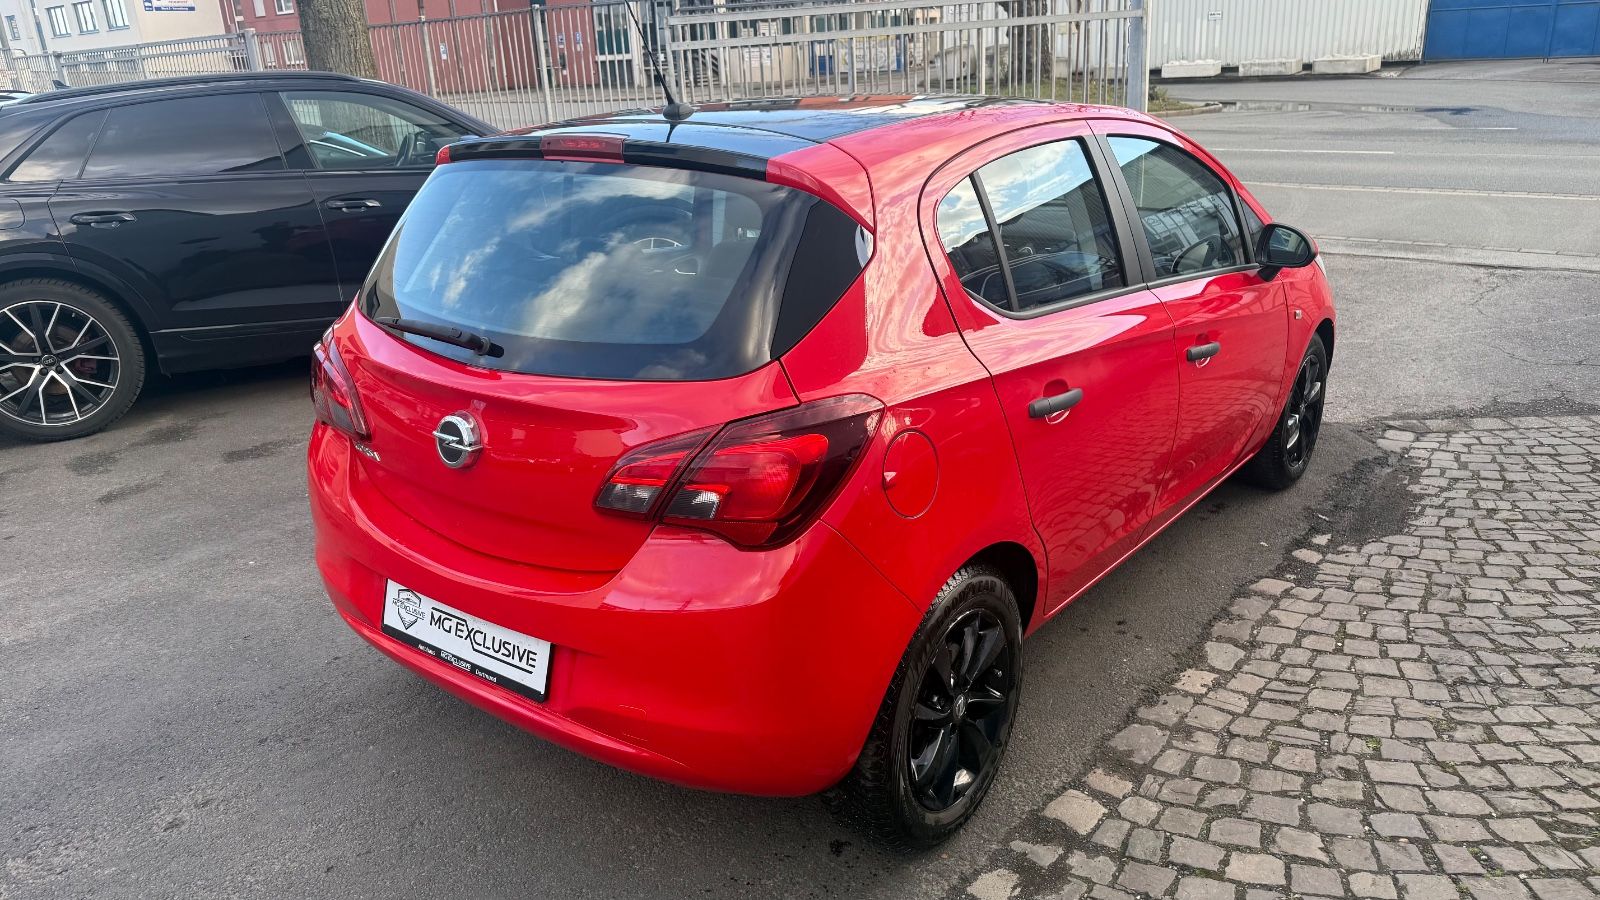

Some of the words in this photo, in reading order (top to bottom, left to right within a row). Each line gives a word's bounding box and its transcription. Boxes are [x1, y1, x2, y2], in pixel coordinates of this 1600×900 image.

[429, 611, 452, 633] MG
[455, 620, 538, 668] EXCLUSIVE
[476, 669, 497, 682] Dortmund
